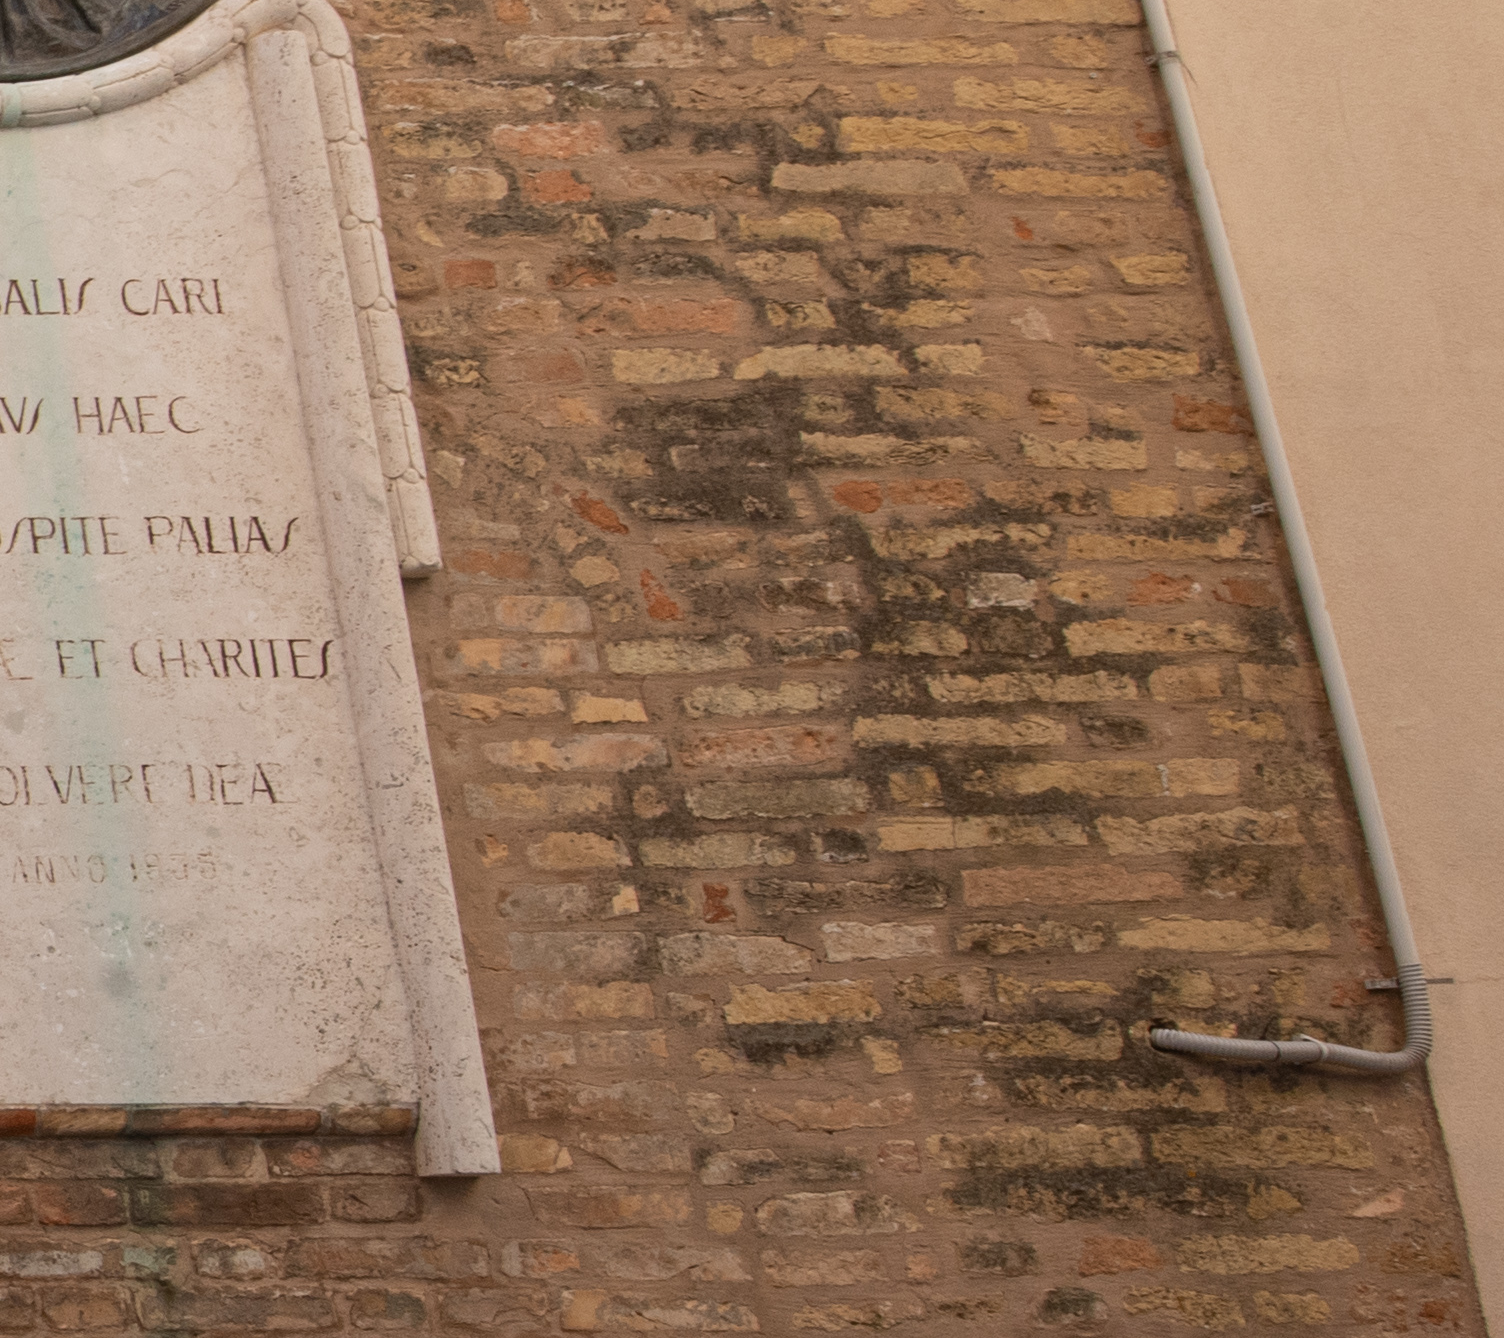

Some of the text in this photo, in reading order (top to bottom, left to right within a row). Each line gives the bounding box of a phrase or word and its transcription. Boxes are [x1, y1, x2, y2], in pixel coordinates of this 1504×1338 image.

[120, 277, 225, 317] CARI
[73, 395, 205, 435] HAEC
[55, 639, 106, 679] ET
[129, 638, 335, 681] CHARITES
